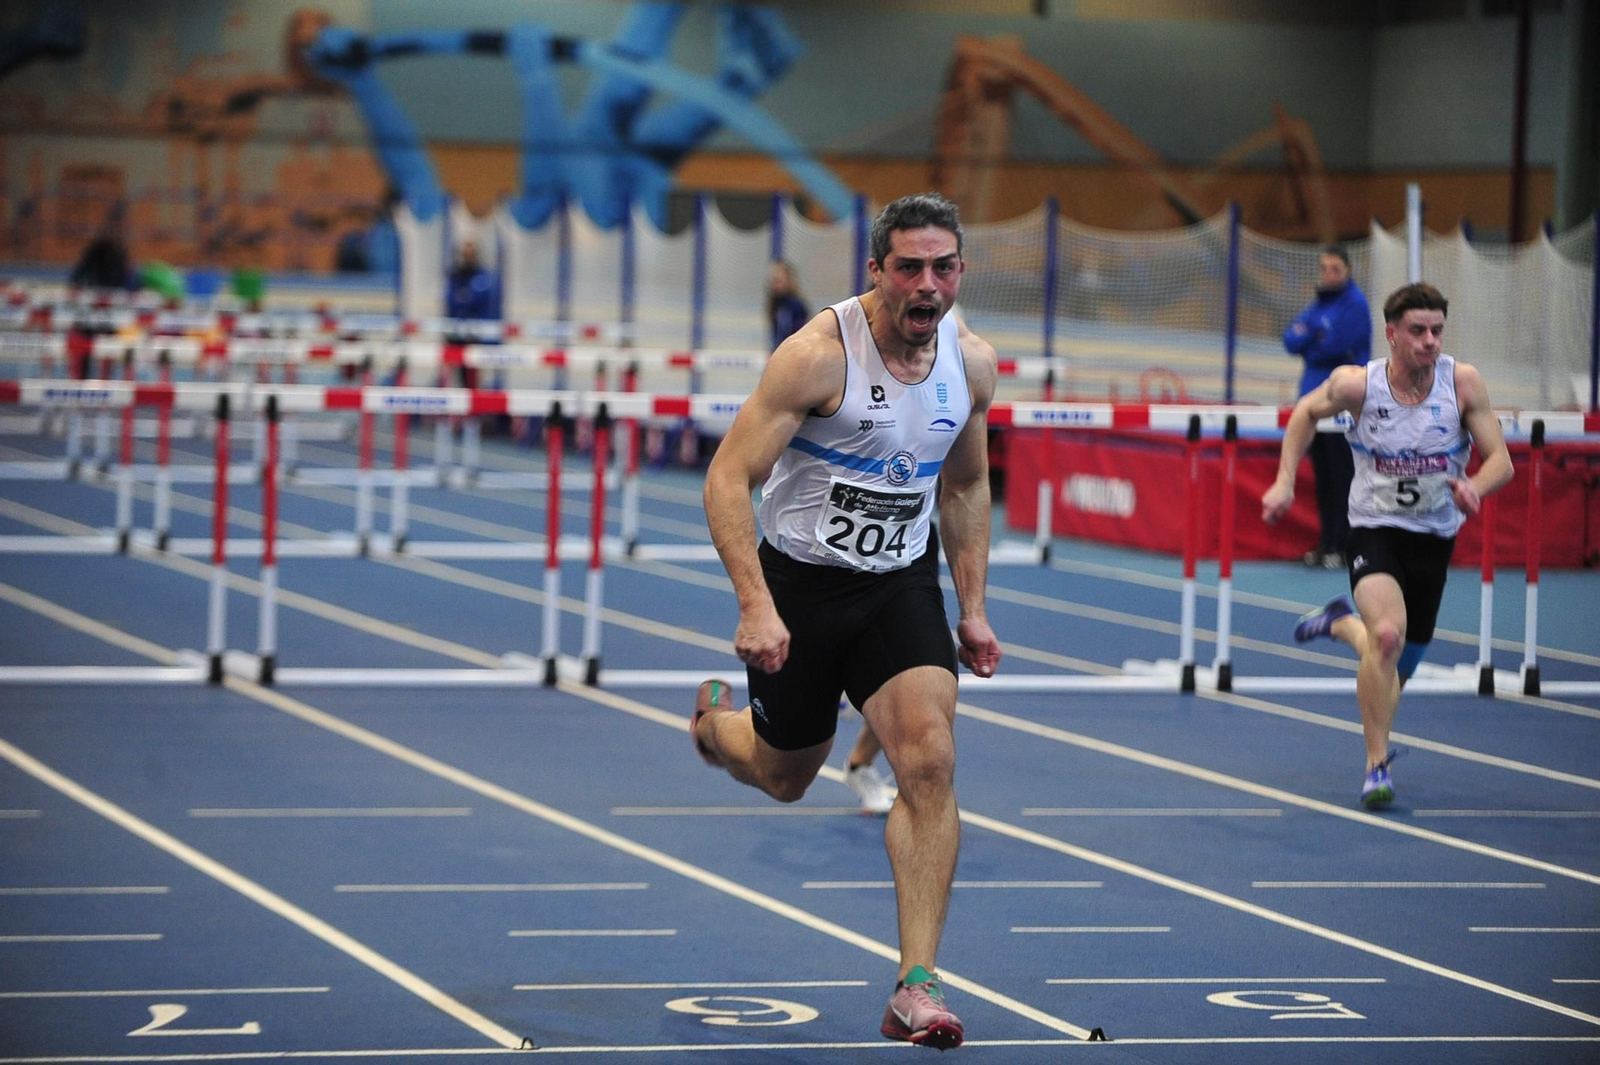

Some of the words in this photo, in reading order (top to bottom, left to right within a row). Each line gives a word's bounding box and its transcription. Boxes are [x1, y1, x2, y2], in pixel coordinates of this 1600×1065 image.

[856, 492, 895, 506] Federación
[1396, 477, 1420, 507] 5
[864, 503, 901, 514] Atletismo
[825, 515, 908, 558] 204
[1206, 990, 1367, 1019] 5
[126, 1003, 261, 1036] 7
